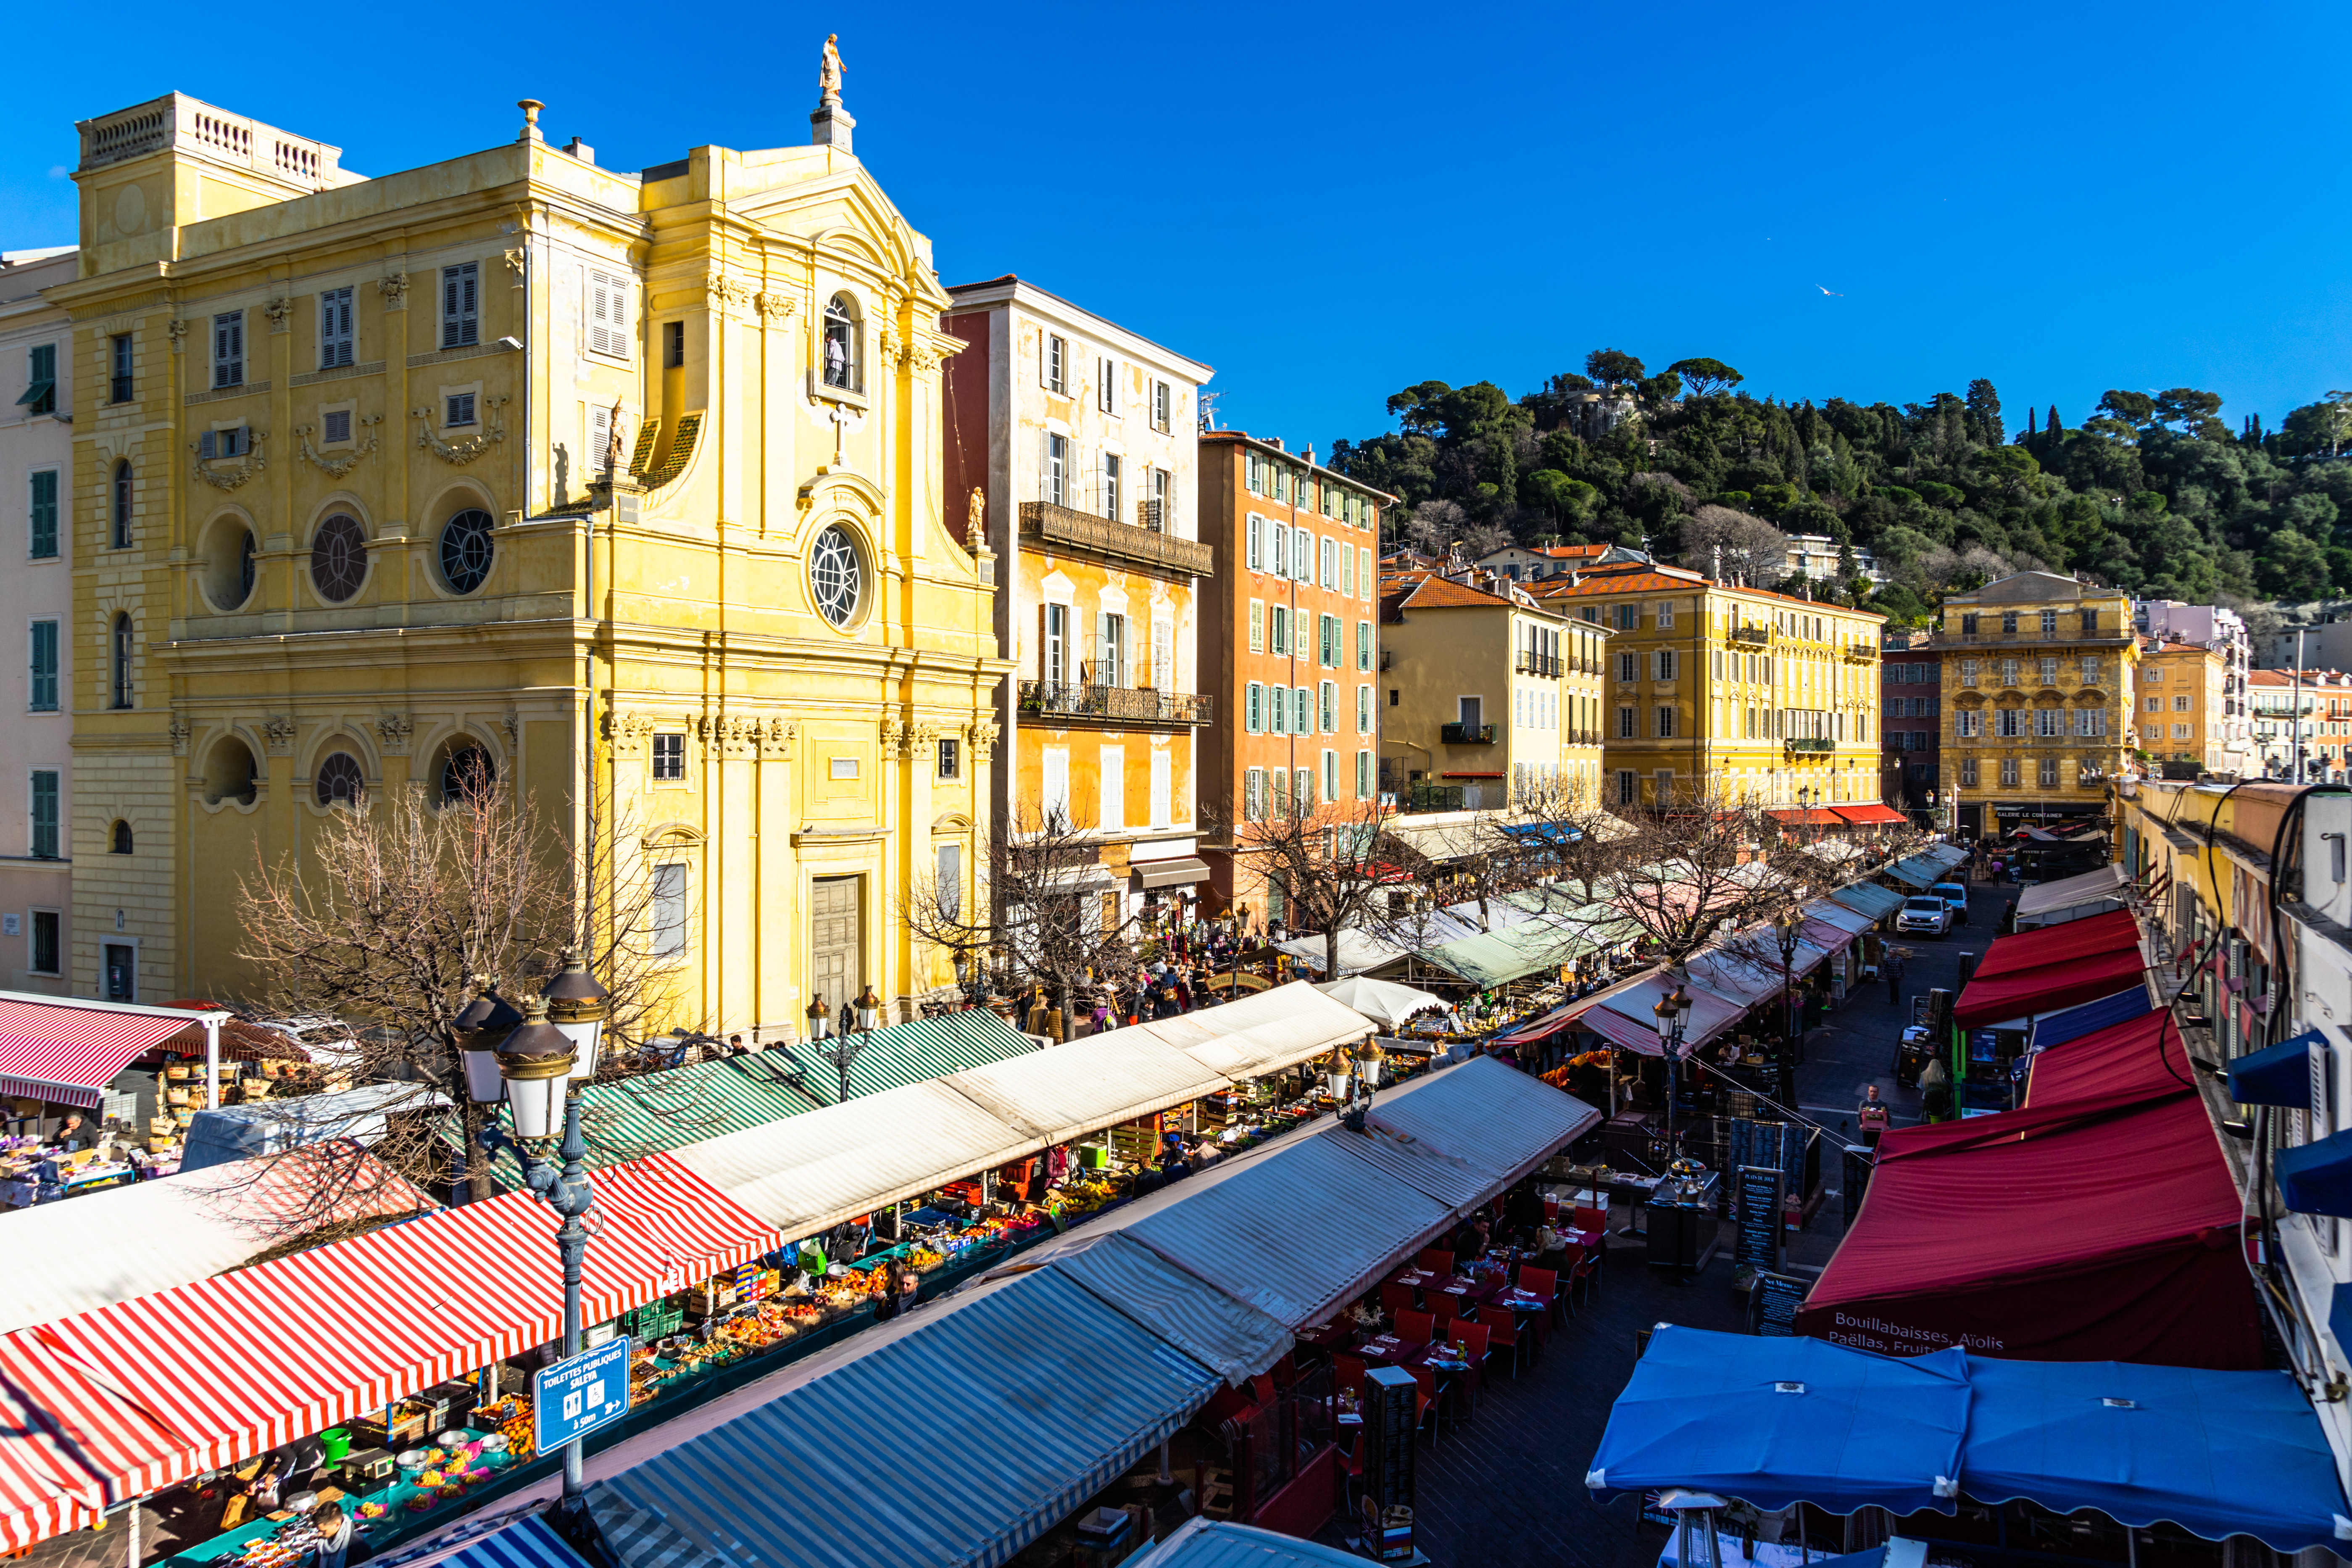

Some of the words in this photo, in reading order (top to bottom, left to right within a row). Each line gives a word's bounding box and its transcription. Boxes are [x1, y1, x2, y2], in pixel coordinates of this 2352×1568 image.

[1214, 976, 1232, 986] CHEZ
[1775, 1280, 1793, 1289] Menu
[1836, 1312, 1953, 1346] Bouillabaisses,
[1958, 1333, 2004, 1350] Aïolis
[1829, 1331, 1888, 1352] Paëllas,
[543, 1365, 582, 1389] TOILETTES
[583, 1349, 622, 1373] PUBLIQUES
[570, 1370, 597, 1390] SALEYA
[503, 1409, 534, 1428] MARIANA
[573, 1420, 579, 1430] à
[580, 1413, 596, 1428] 50m
